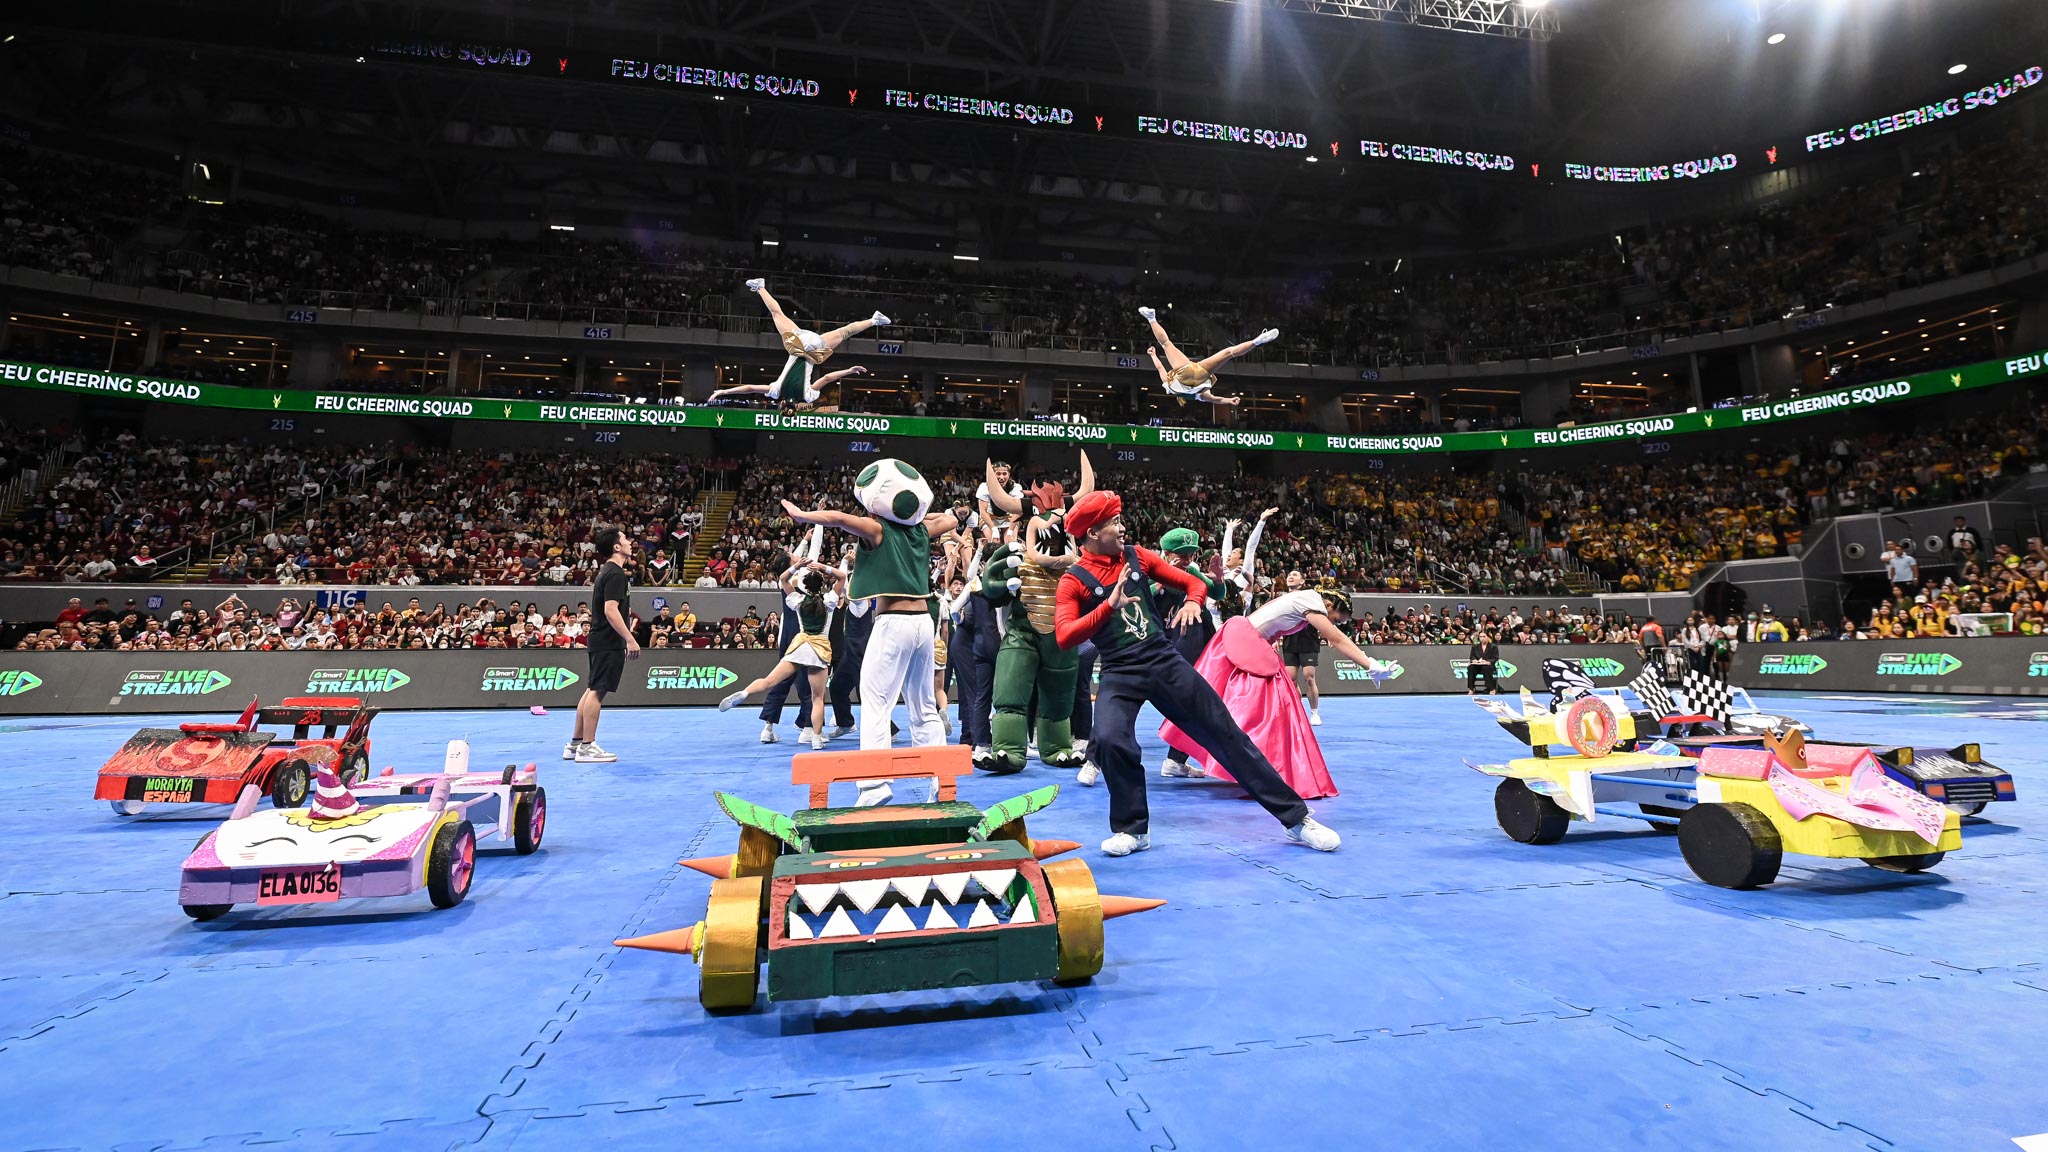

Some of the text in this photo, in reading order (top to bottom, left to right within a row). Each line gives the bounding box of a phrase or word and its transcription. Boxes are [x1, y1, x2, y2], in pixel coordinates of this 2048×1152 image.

[653, 63, 750, 90] CHEERING
[754, 74, 820, 97] SQUAD
[923, 93, 1011, 118] CHEERING
[1013, 103, 1074, 125] SQUAD
[1849, 97, 1961, 142] CHEERING
[1963, 65, 2044, 110] SQUAD
[1172, 119, 1251, 143] CHEERING
[1253, 128, 1308, 149] SQUAD
[1391, 143, 1464, 166] CHEERING
[1465, 151, 1515, 171] SQUAD
[1593, 165, 1670, 182] CHEERING
[1672, 153, 1738, 179] SQUAD
[289, 311, 313, 323] 415
[586, 328, 611, 340] 416
[879, 343, 899, 355] 417
[1119, 357, 1138, 368] 418
[2005, 355, 2041, 376] FEU
[0, 363, 201, 400] FEU CHEERING SQUAD
[1360, 370, 1379, 381] 419
[314, 395, 474, 418] FEU CHEERING SQUAD
[1741, 381, 1911, 422] FEU CHEERING SQUAD
[540, 405, 687, 426] FEU CHEERING SQUAD
[271, 419, 295, 432] 215
[755, 413, 890, 433] FEU CHEERING SQUAD
[594, 431, 617, 444] 216
[983, 422, 1108, 441] FEU CHEERING SQUAD
[1159, 429, 1274, 447] FEU CHEERING SQUAD
[1533, 418, 1674, 445] FEU CHEERING SQUAD
[849, 441, 870, 453] 217
[1327, 436, 1443, 451] FEU CHEERING SQUAD
[1643, 442, 1670, 455] 220
[1117, 450, 1136, 462] 218
[1367, 458, 1384, 470] 219
[325, 590, 358, 609] 116
[1581, 657, 1608, 668] LIVE
[1783, 655, 1811, 665] LIVE
[1906, 653, 1941, 664] LIVE
[138, 669, 209, 682] Smart LIVE
[345, 667, 389, 681] LIVE
[494, 666, 558, 679] Smart LIVE
[658, 665, 718, 678] Smart LIVE
[1337, 669, 1373, 681] STRE
[1758, 664, 1809, 675] STREAM
[1876, 664, 1939, 676] STREAM
[118, 682, 203, 696] STREAM
[304, 680, 384, 694] STREAM
[481, 679, 555, 692] STREAM
[646, 677, 716, 690] STREAM
[145, 777, 194, 791] MORAYTA
